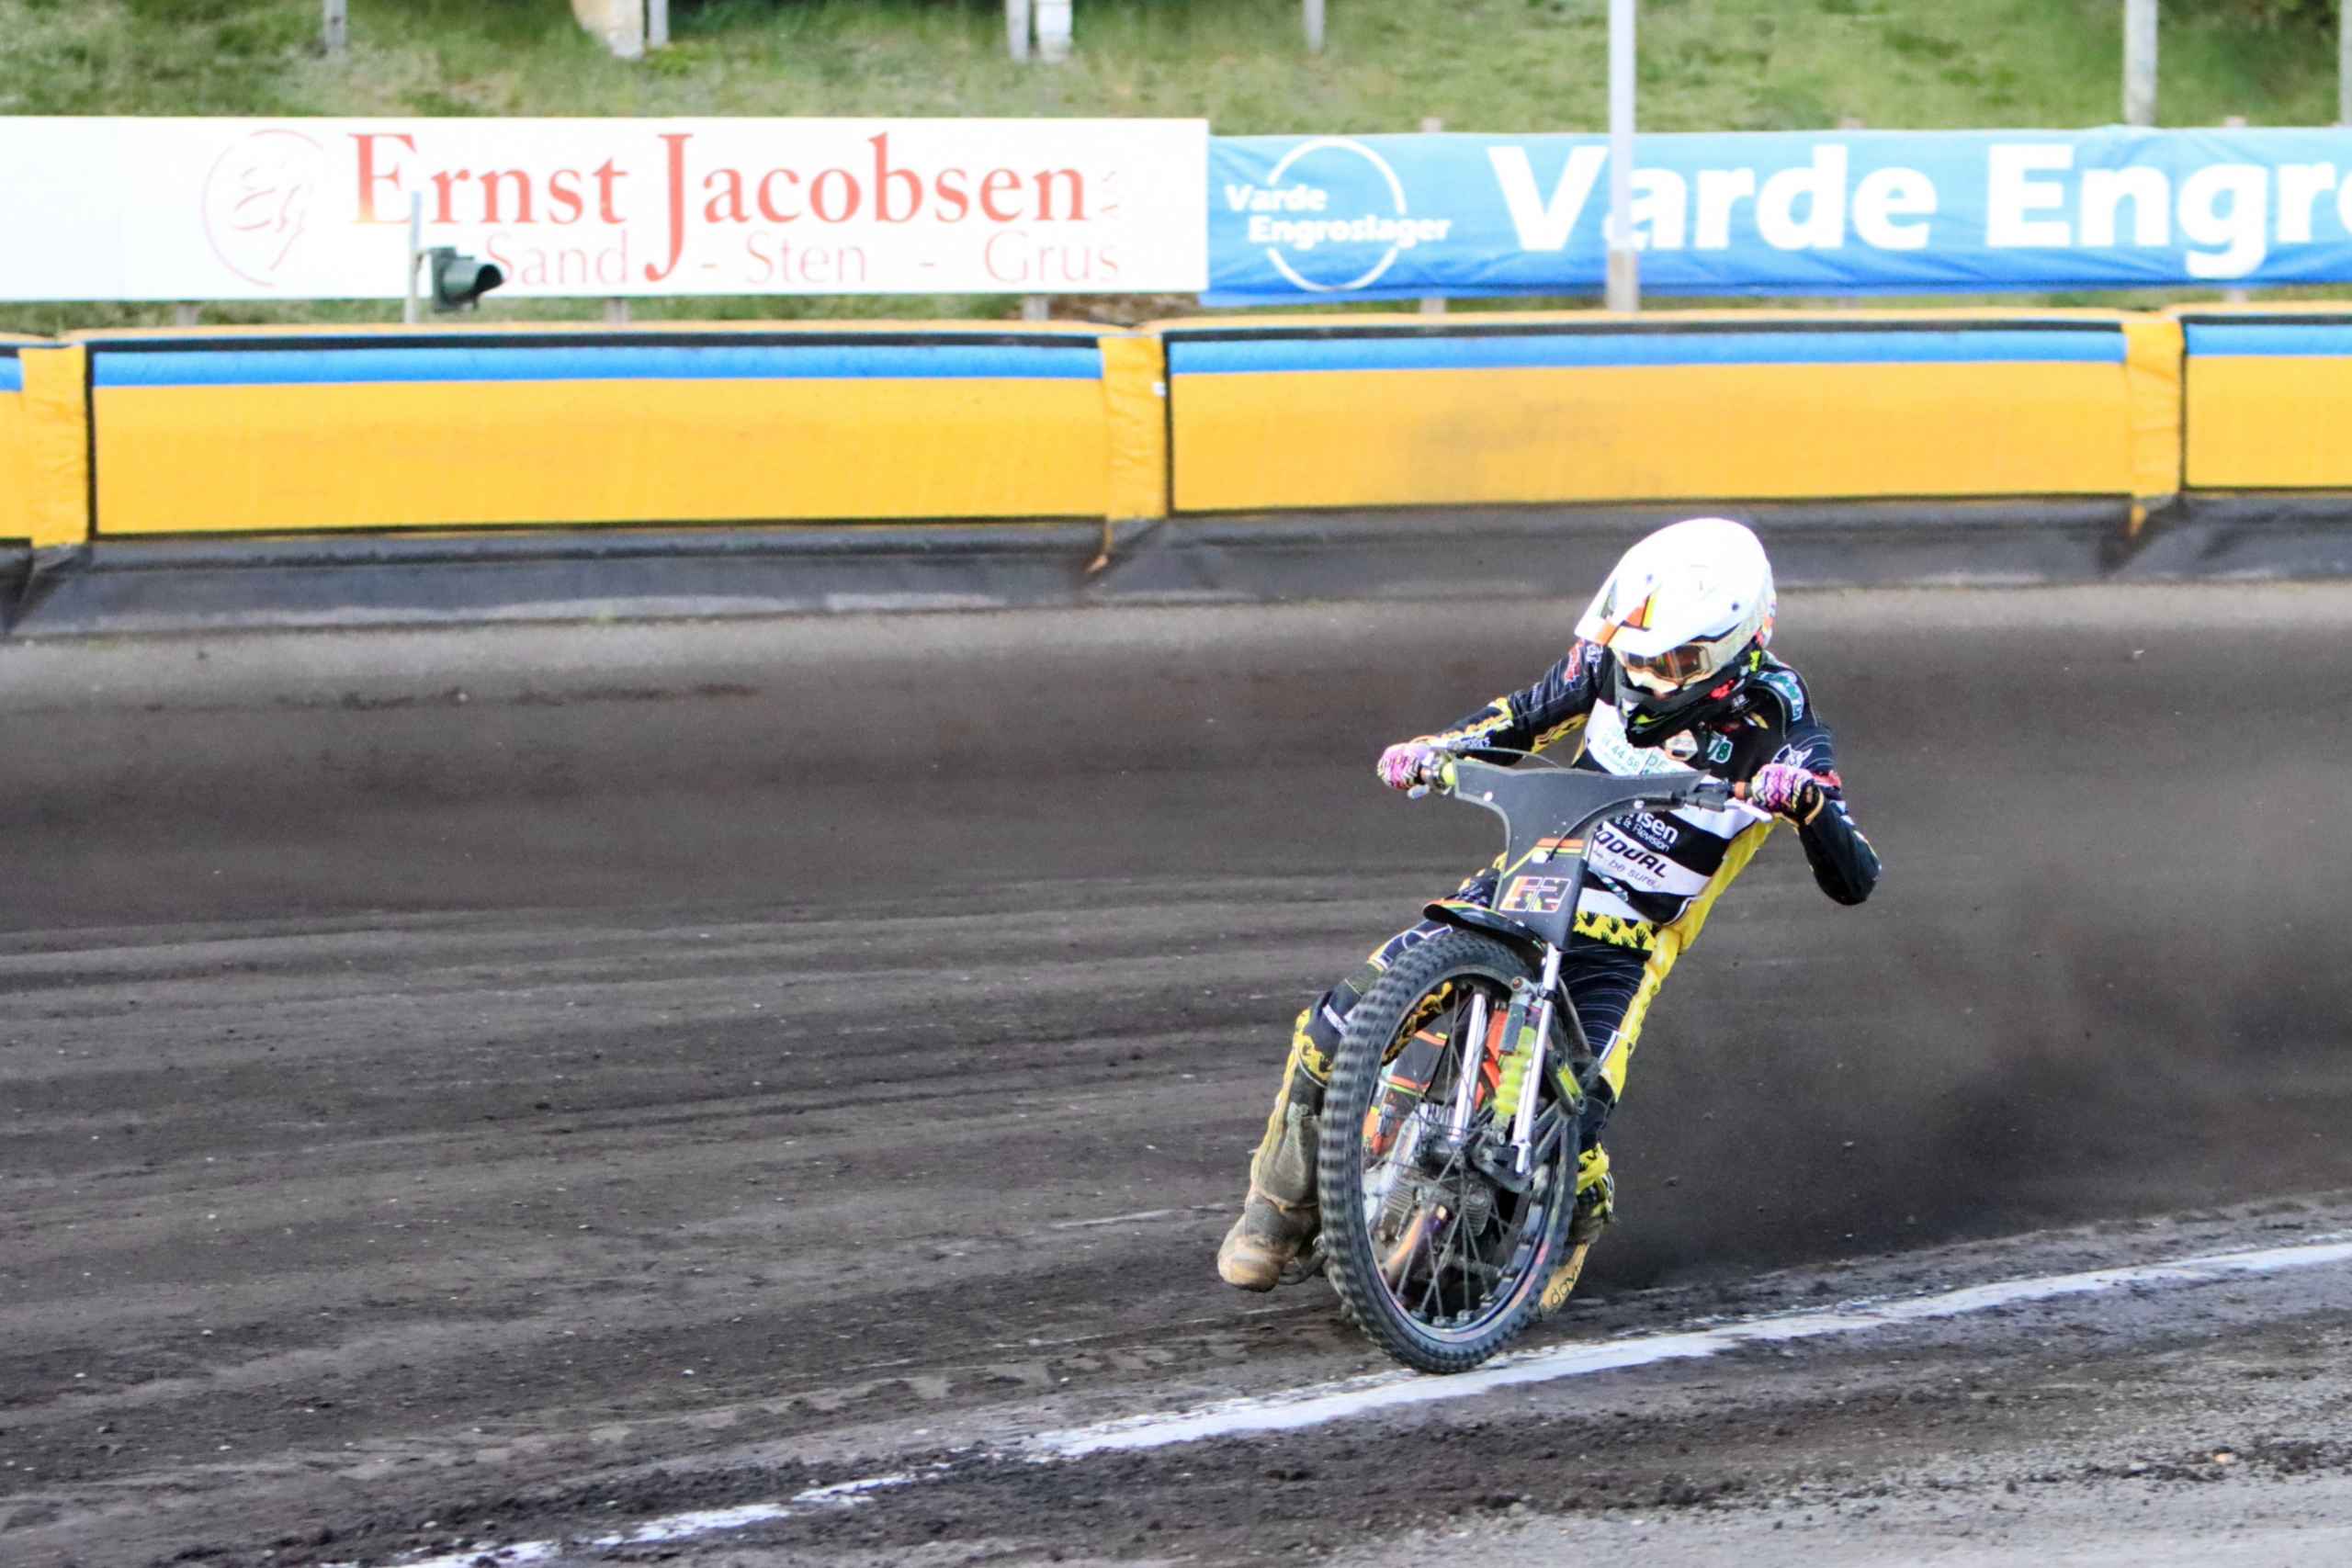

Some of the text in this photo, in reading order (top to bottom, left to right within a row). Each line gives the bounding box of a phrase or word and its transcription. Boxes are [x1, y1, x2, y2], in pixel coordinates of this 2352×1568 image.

[346, 132, 628, 225] Ernst
[644, 131, 1088, 282] Jacobsen
[1224, 184, 1329, 212] Varde
[1486, 141, 2352, 279] Varde Engr
[1248, 214, 1452, 251] Engroslager
[485, 230, 628, 285] Sand
[745, 230, 867, 285] Sten
[983, 230, 1118, 283] Grus
[1595, 829, 1668, 878] ODUAL
[1632, 823, 1670, 852] Revision
[1608, 858, 1626, 874] be
